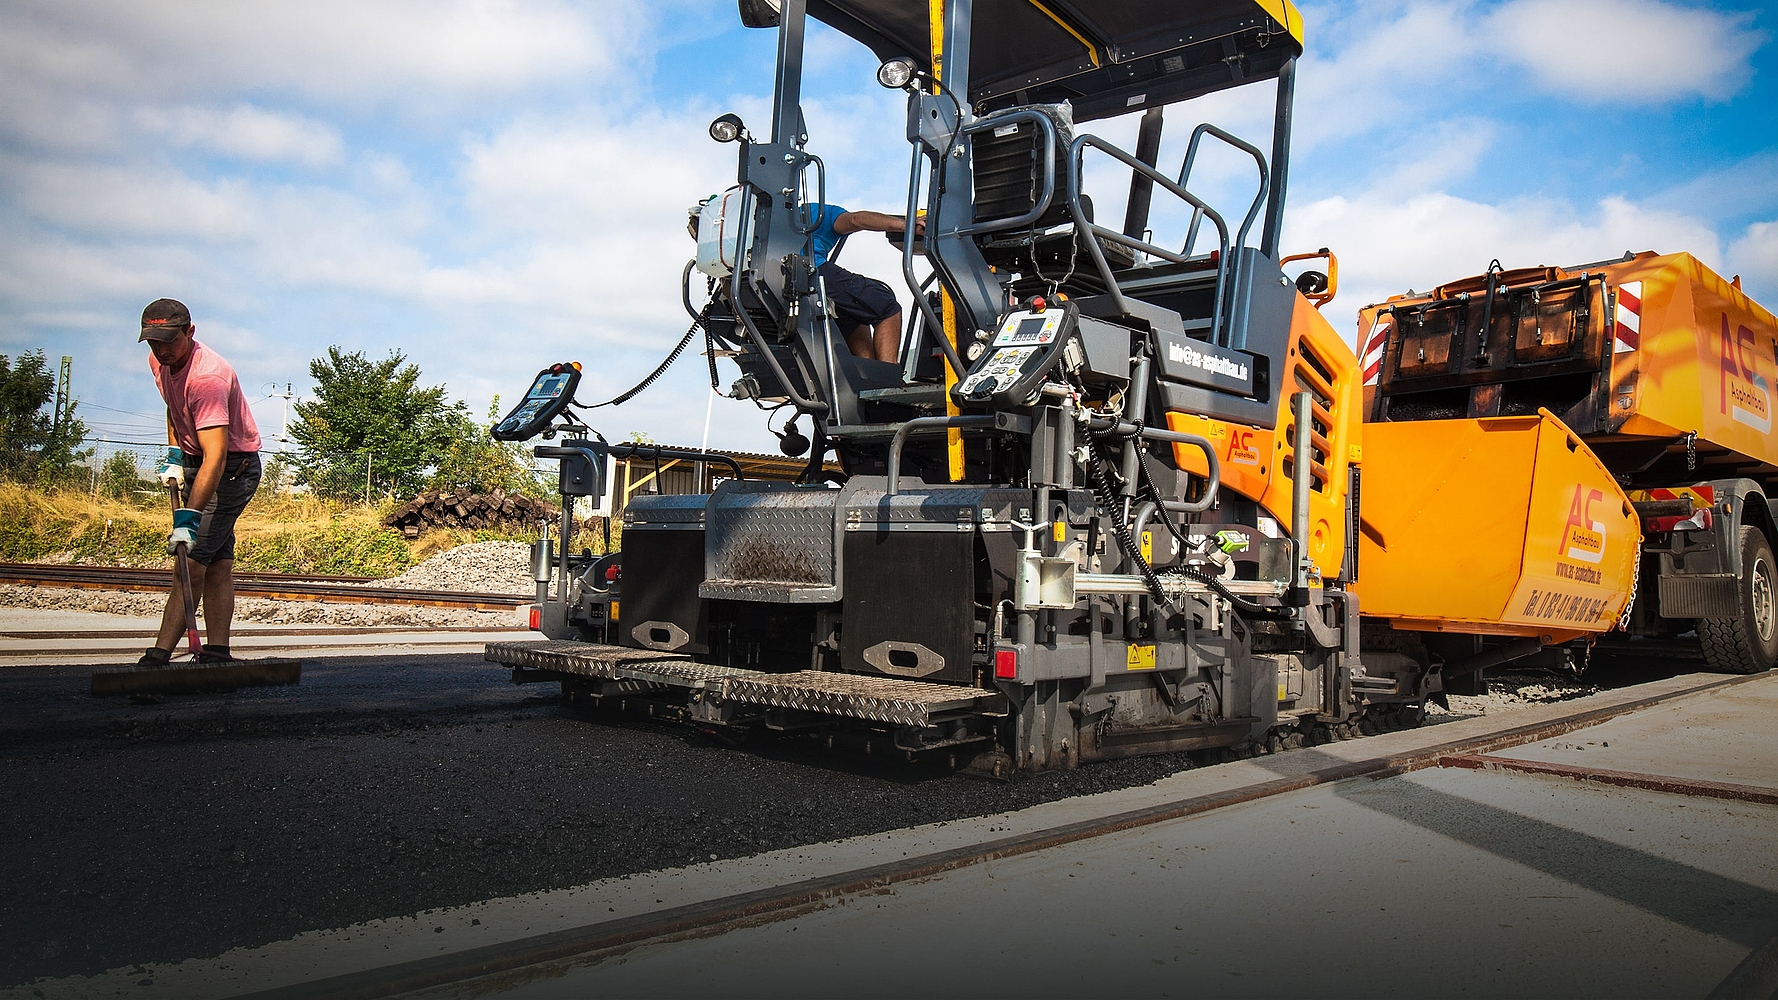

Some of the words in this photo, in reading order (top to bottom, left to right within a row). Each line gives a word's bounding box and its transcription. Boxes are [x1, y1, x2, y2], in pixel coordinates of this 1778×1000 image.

[1731, 381, 1765, 412] Asphaltbau
[1571, 530, 1600, 549] Asphaltbau
[1536, 591, 1551, 618] 0
[1543, 592, 1562, 619] 83
